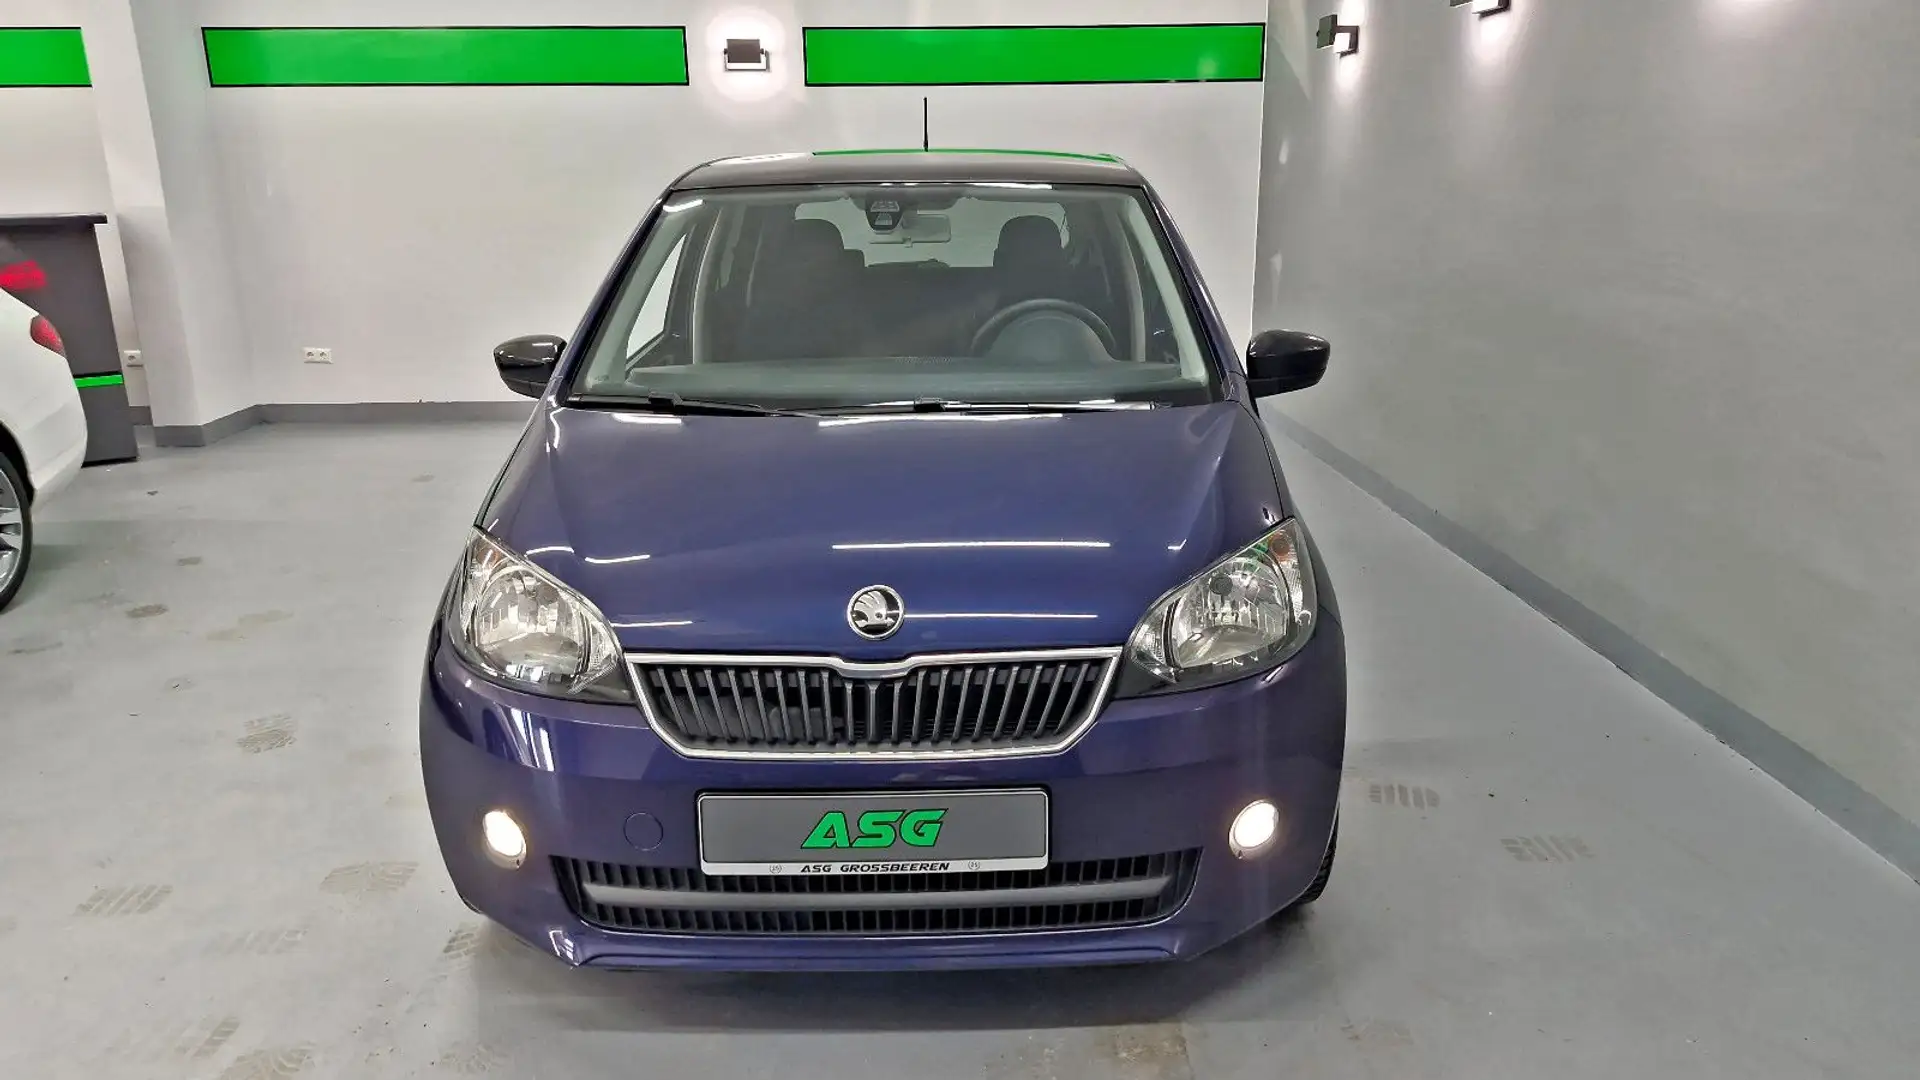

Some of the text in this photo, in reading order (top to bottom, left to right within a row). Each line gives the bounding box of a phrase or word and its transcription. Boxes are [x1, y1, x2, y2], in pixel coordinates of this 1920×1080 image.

[801, 808, 949, 849] ASG
[801, 862, 950, 873] ASG GROSSBEEREN
